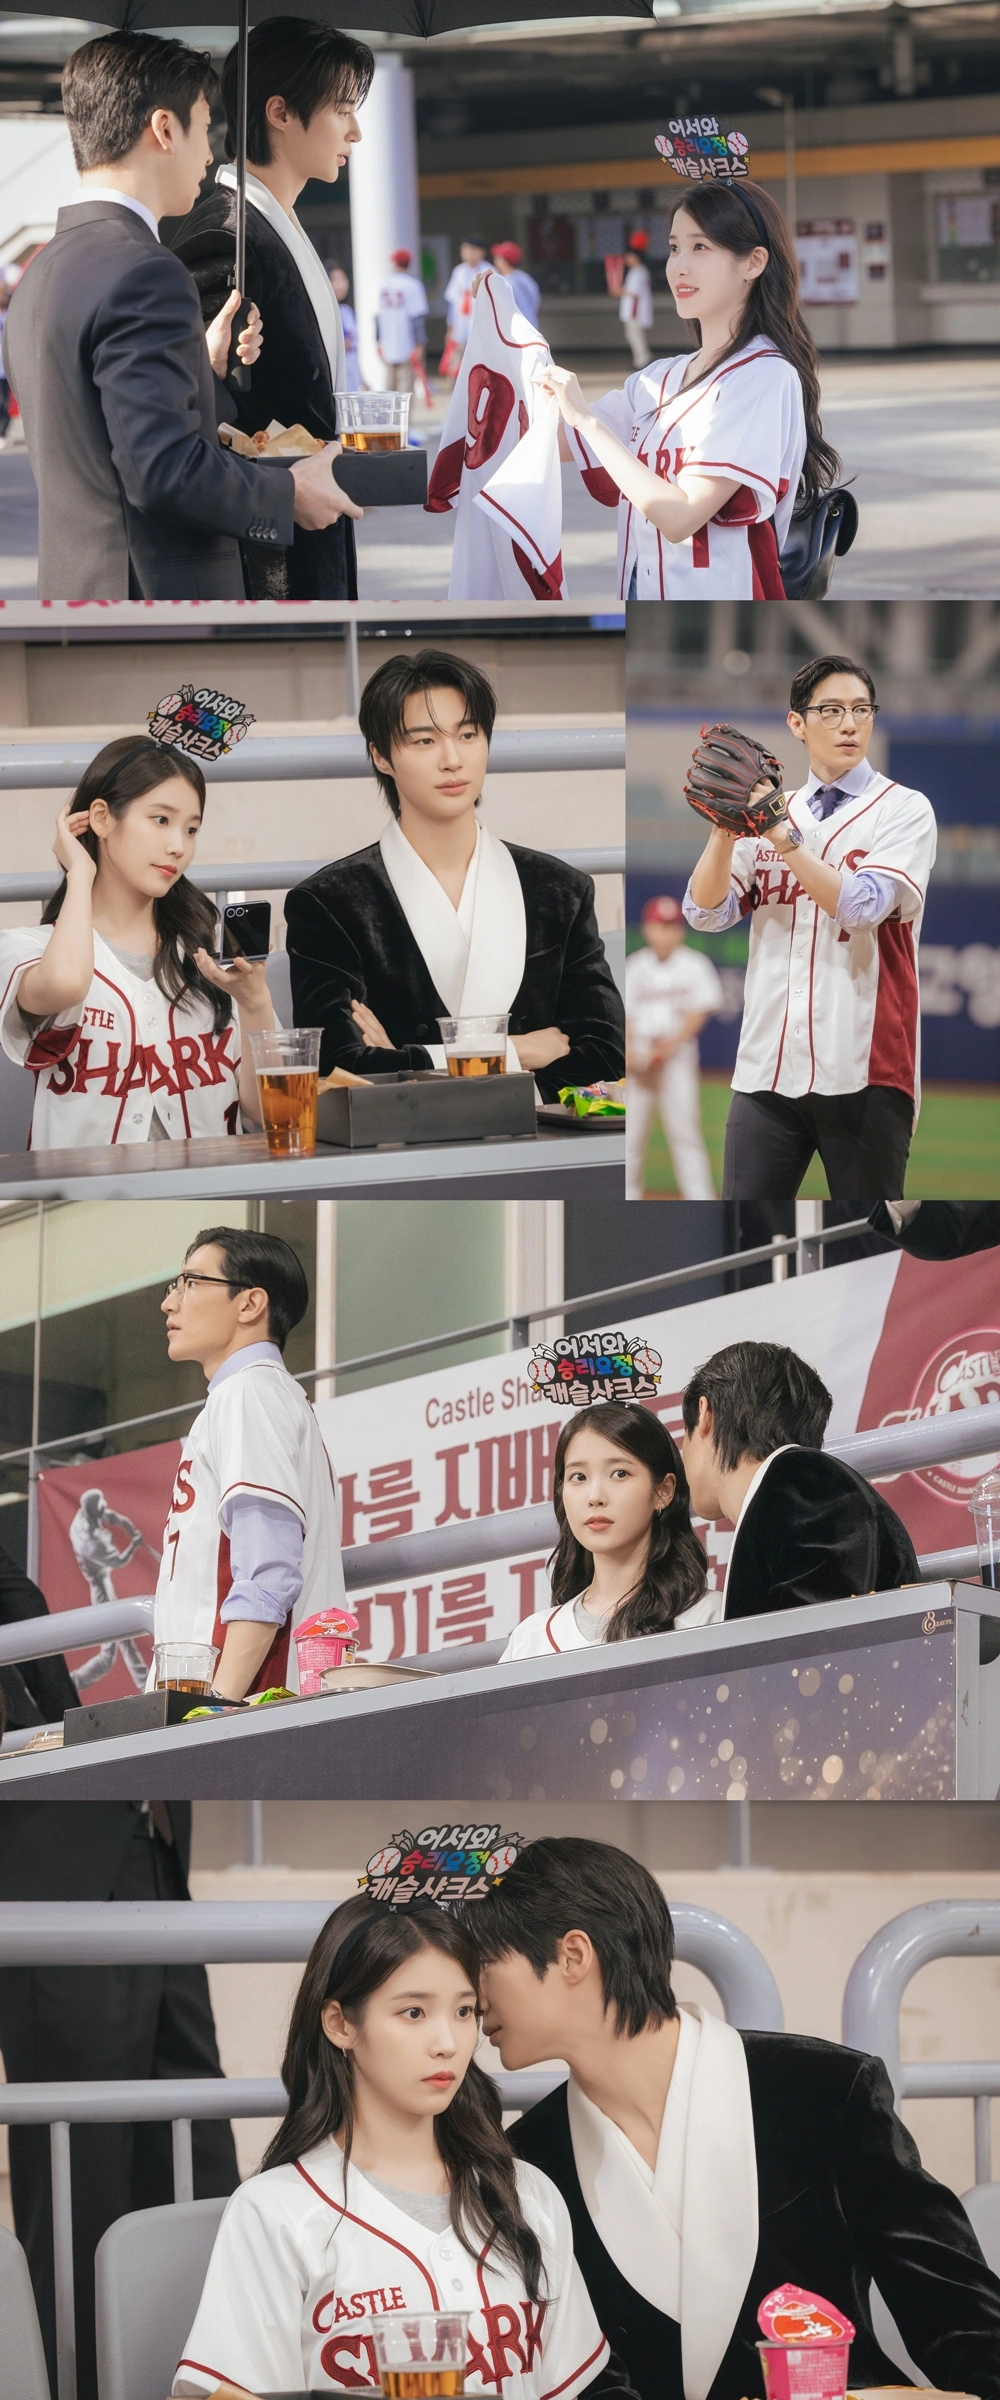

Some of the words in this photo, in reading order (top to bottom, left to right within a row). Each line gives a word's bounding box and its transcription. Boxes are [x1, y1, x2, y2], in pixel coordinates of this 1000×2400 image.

[668, 117, 719, 138] 어서와
[673, 136, 728, 157] 승리요정
[668, 157, 748, 179] 캐슬샤크스
[194, 689, 244, 721] 어서와
[174, 702, 233, 739] 승리요정
[149, 714, 222, 761] 캐슬샤크스
[555, 1332, 626, 1358] 어서와
[557, 1354, 633, 1380] 승리요정
[425, 1387, 494, 1429] Castle
[501, 1376, 543, 1411] Sha
[543, 1376, 656, 1404] 캐슬샤크스
[417, 1827, 498, 1851] 어서와
[400, 1850, 491, 1875] 승리요정
[368, 1876, 490, 1904] 캐슬샤크스
[312, 2286, 407, 2334] CASTLE
